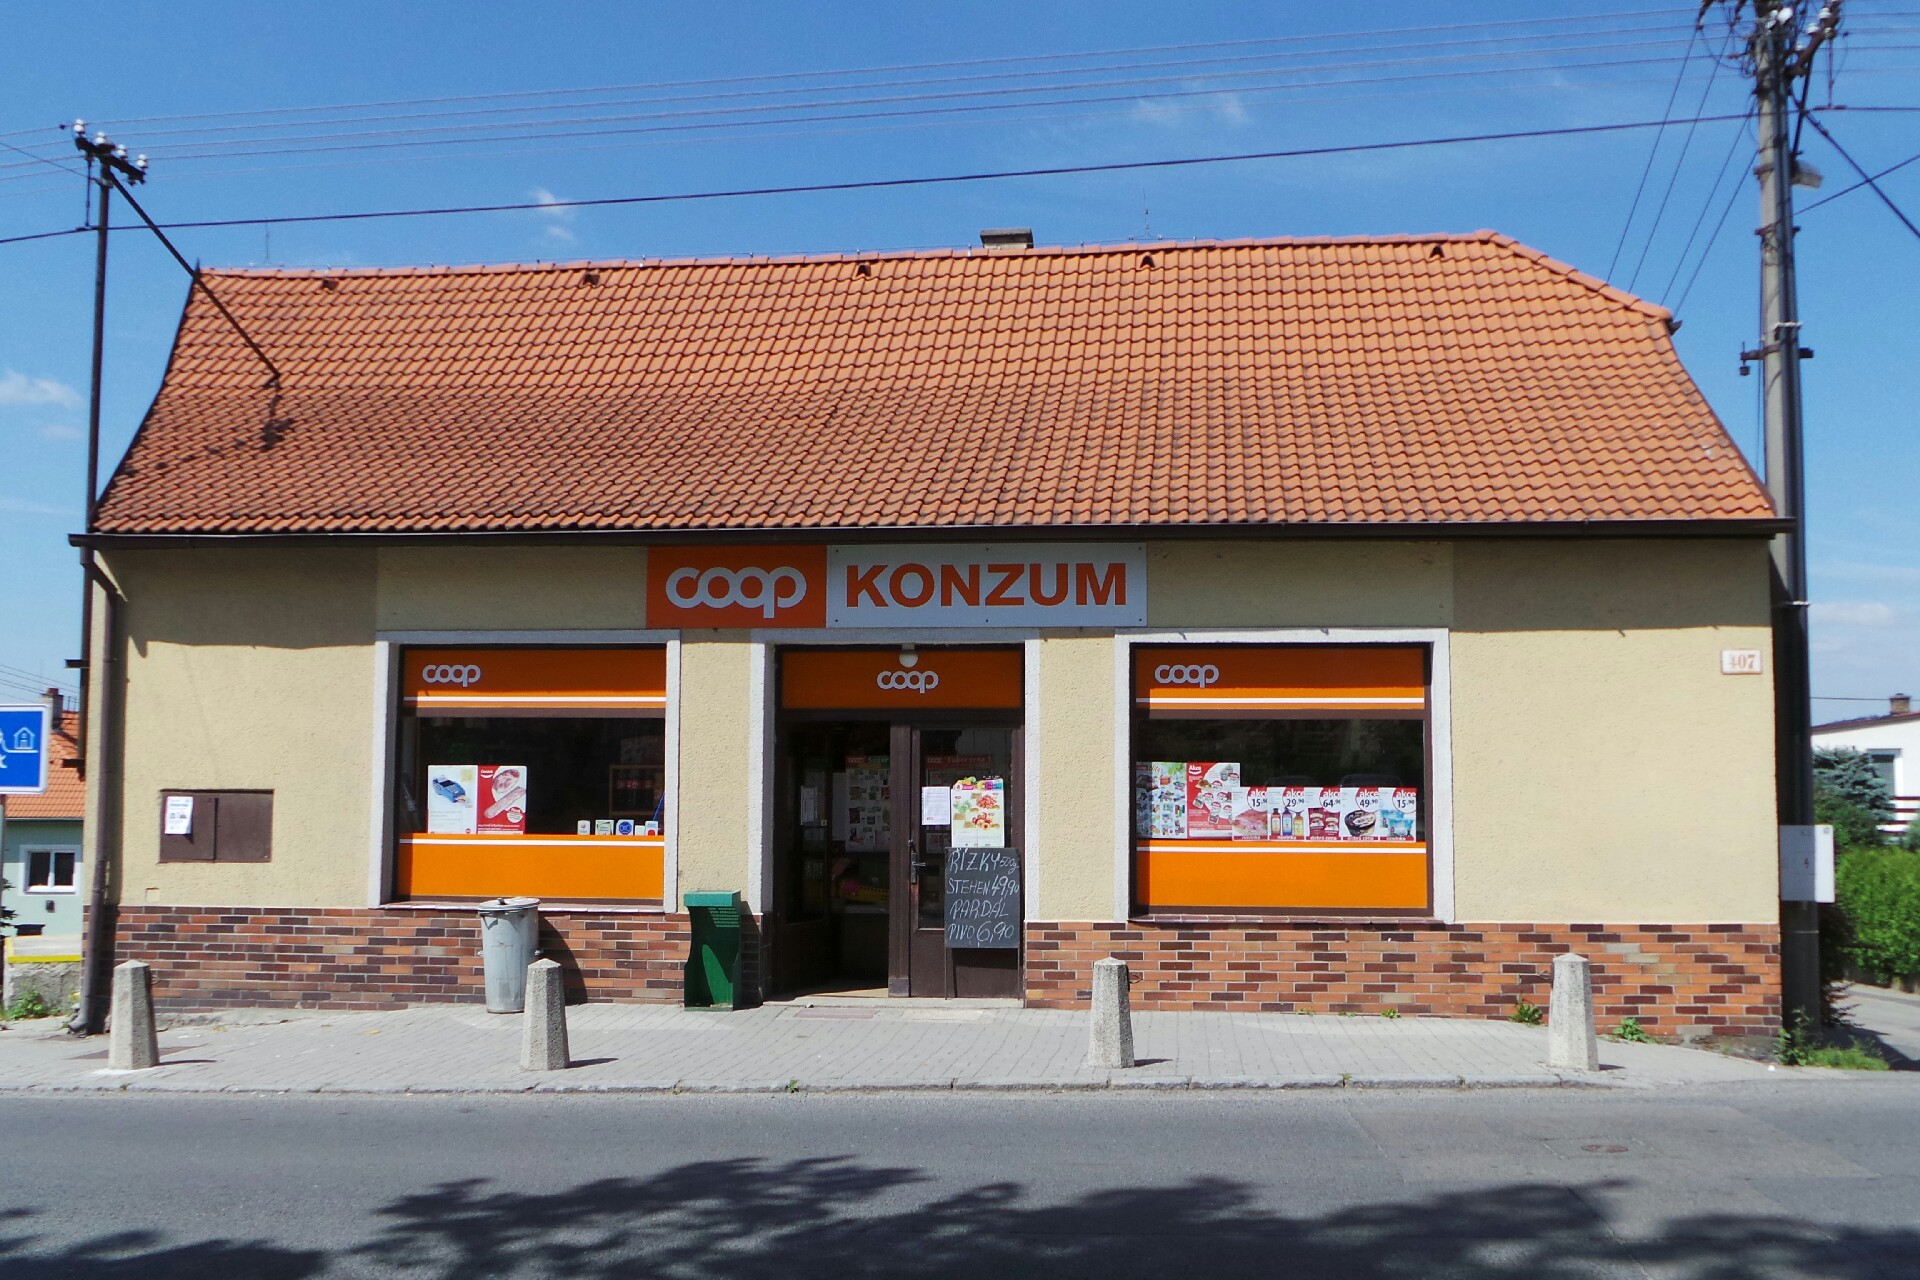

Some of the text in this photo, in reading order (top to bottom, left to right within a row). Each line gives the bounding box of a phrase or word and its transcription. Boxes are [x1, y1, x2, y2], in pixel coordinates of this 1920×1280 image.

[665, 566, 807, 619] coop
[846, 562, 1127, 608] KONZUM
[1728, 653, 1756, 669] 407
[422, 664, 481, 687] coop
[876, 670, 940, 694] coop
[1154, 664, 1220, 688] coop
[1360, 789, 1379, 798] akce
[1397, 789, 1416, 798] akce
[947, 923, 975, 941] PIVO
